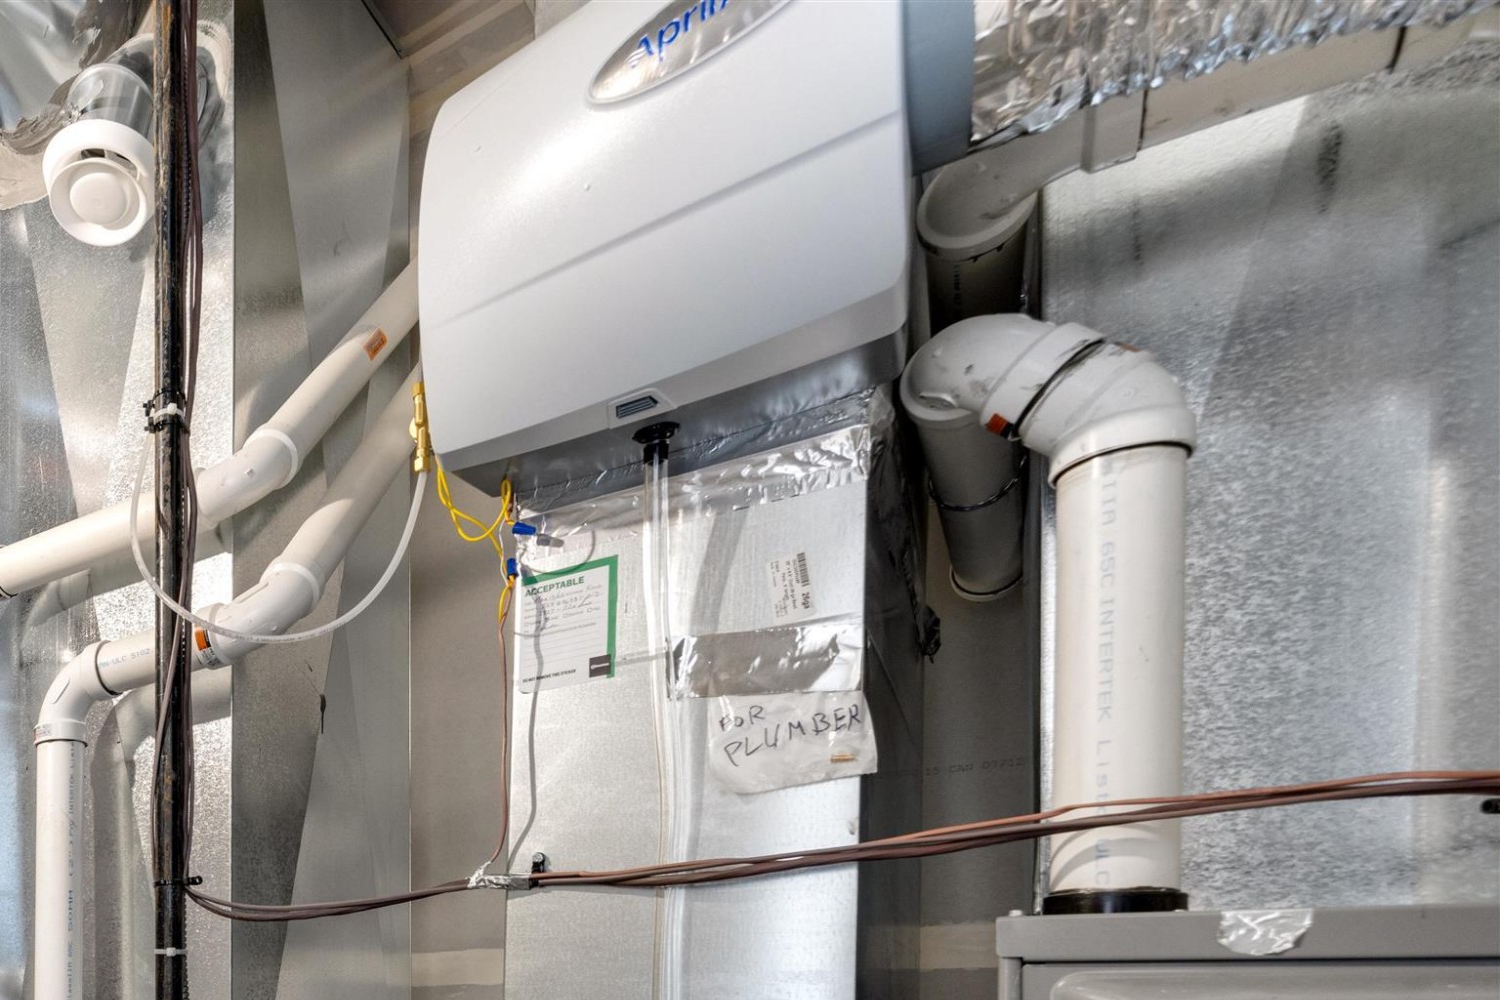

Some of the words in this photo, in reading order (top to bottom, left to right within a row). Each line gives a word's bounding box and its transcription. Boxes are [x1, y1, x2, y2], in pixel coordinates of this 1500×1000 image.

[524, 576, 585, 597] ACCEPTABLE
[1097, 597, 1116, 720] INTERTEK
[719, 705, 765, 731] FOR
[724, 703, 862, 767] PLUMBER
